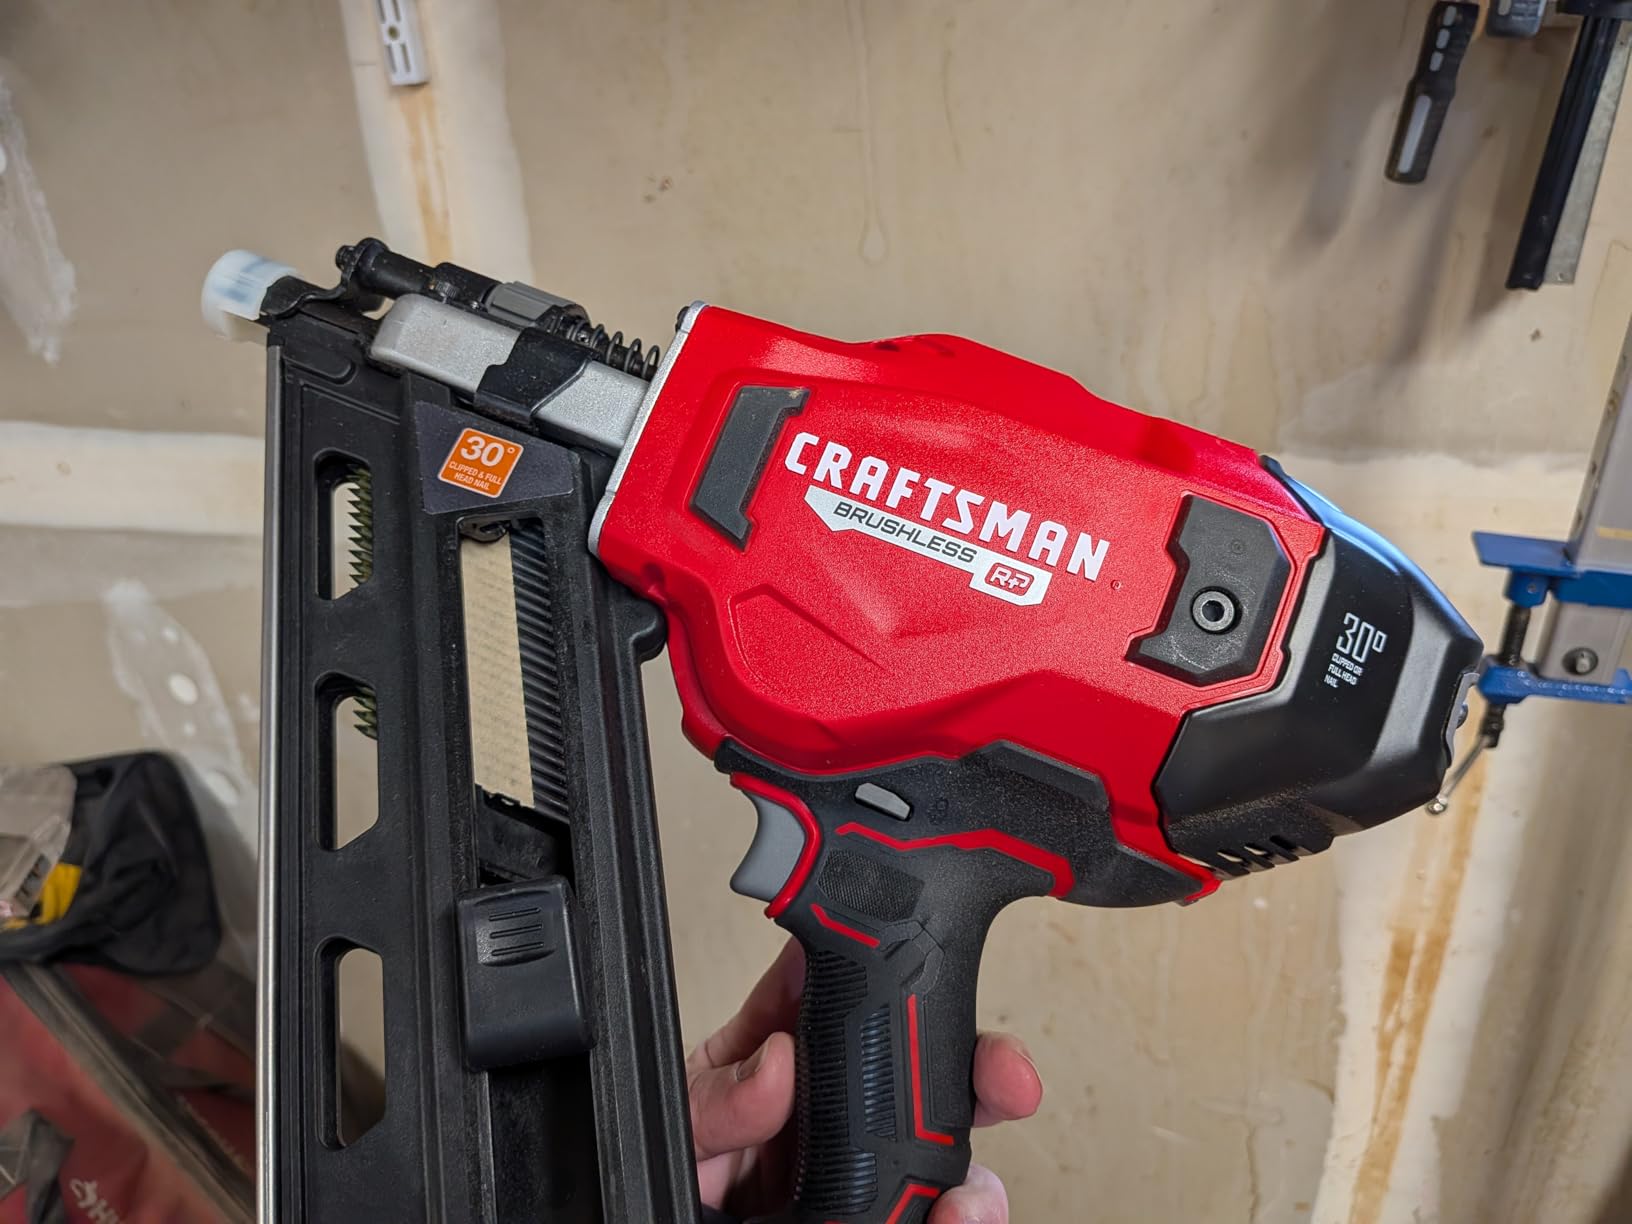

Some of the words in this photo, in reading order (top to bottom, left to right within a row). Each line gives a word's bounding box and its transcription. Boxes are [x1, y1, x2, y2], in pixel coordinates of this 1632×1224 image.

[449, 461, 479, 476] CLIPPED
[477, 471, 485, 479] &
[485, 473, 502, 485] FULL
[454, 473, 474, 484] HEAD
[474, 480, 490, 490] NAIL
[785, 432, 1110, 581] CRAFTSMAN
[833, 502, 977, 563] BRUSHLESS
[1331, 653, 1354, 671] CLIPPED
[1323, 674, 1339, 688] NAIL
[1327, 663, 1342, 678] FULL
[1341, 671, 1358, 686] HEAD
